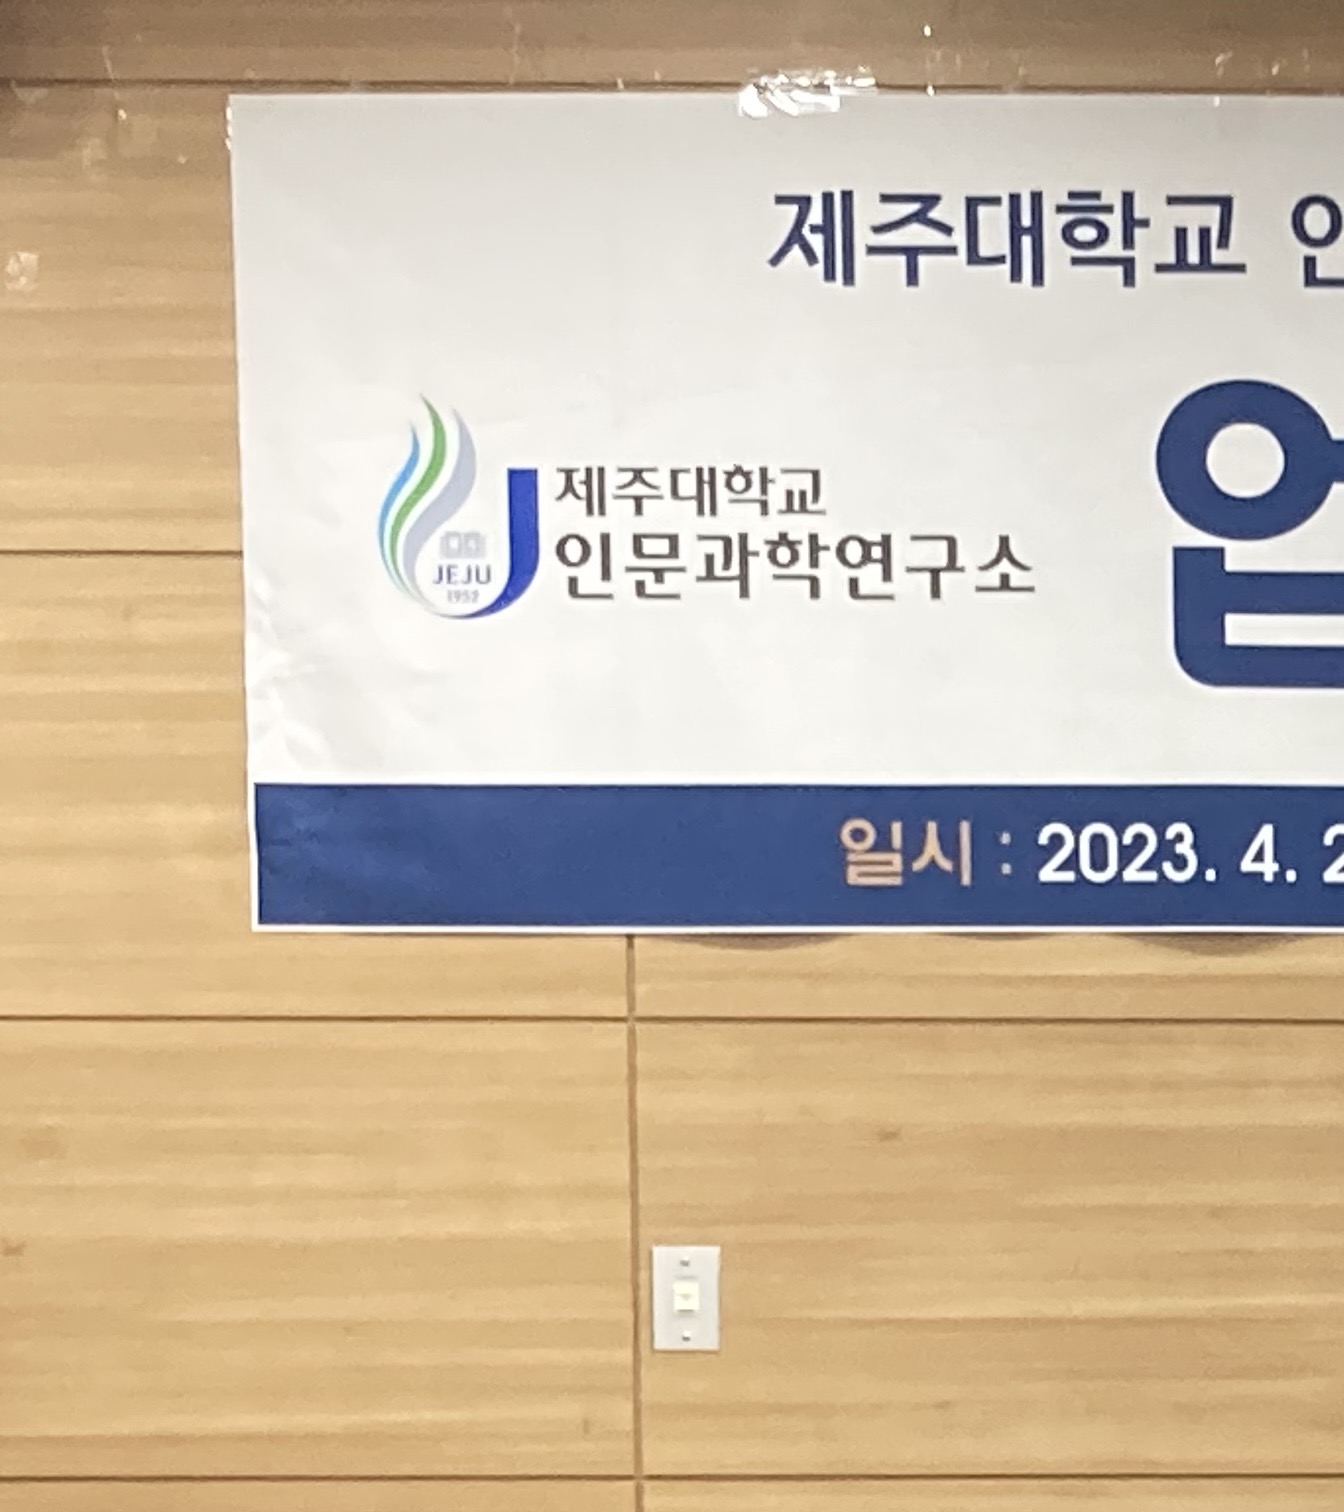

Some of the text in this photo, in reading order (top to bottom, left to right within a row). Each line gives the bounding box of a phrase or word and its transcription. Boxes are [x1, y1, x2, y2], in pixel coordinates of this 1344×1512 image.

[769, 189, 1248, 288] 제주대학교
[555, 463, 827, 517] 제주대학교
[433, 564, 491, 585] JEJU
[555, 531, 1036, 601] 인문과학연구소
[840, 819, 971, 886] 일시
[1038, 822, 1217, 883] 2023.
[1240, 823, 1297, 883] 4.
